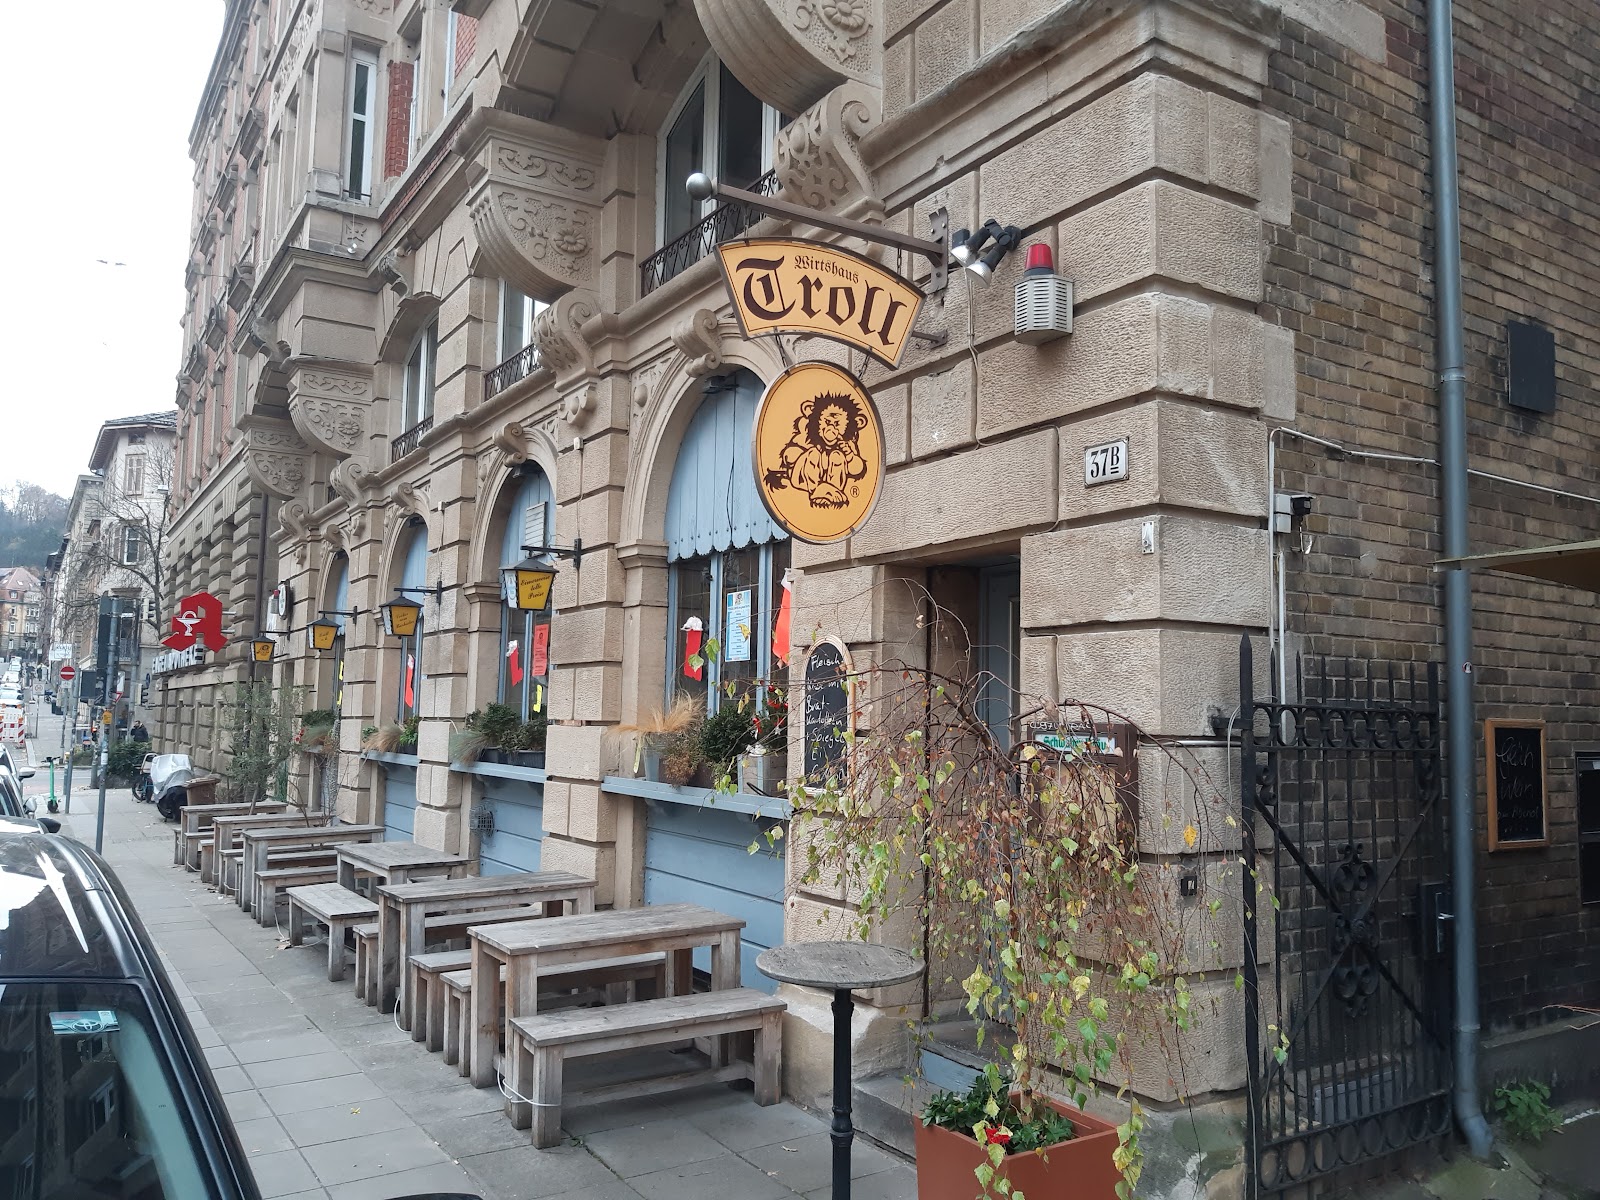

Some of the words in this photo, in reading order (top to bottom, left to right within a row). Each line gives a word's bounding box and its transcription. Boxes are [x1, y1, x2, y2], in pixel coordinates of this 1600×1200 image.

[794, 254, 859, 284] Wirtshaus
[736, 255, 907, 346] Troll
[1090, 445, 1121, 478] 37B
